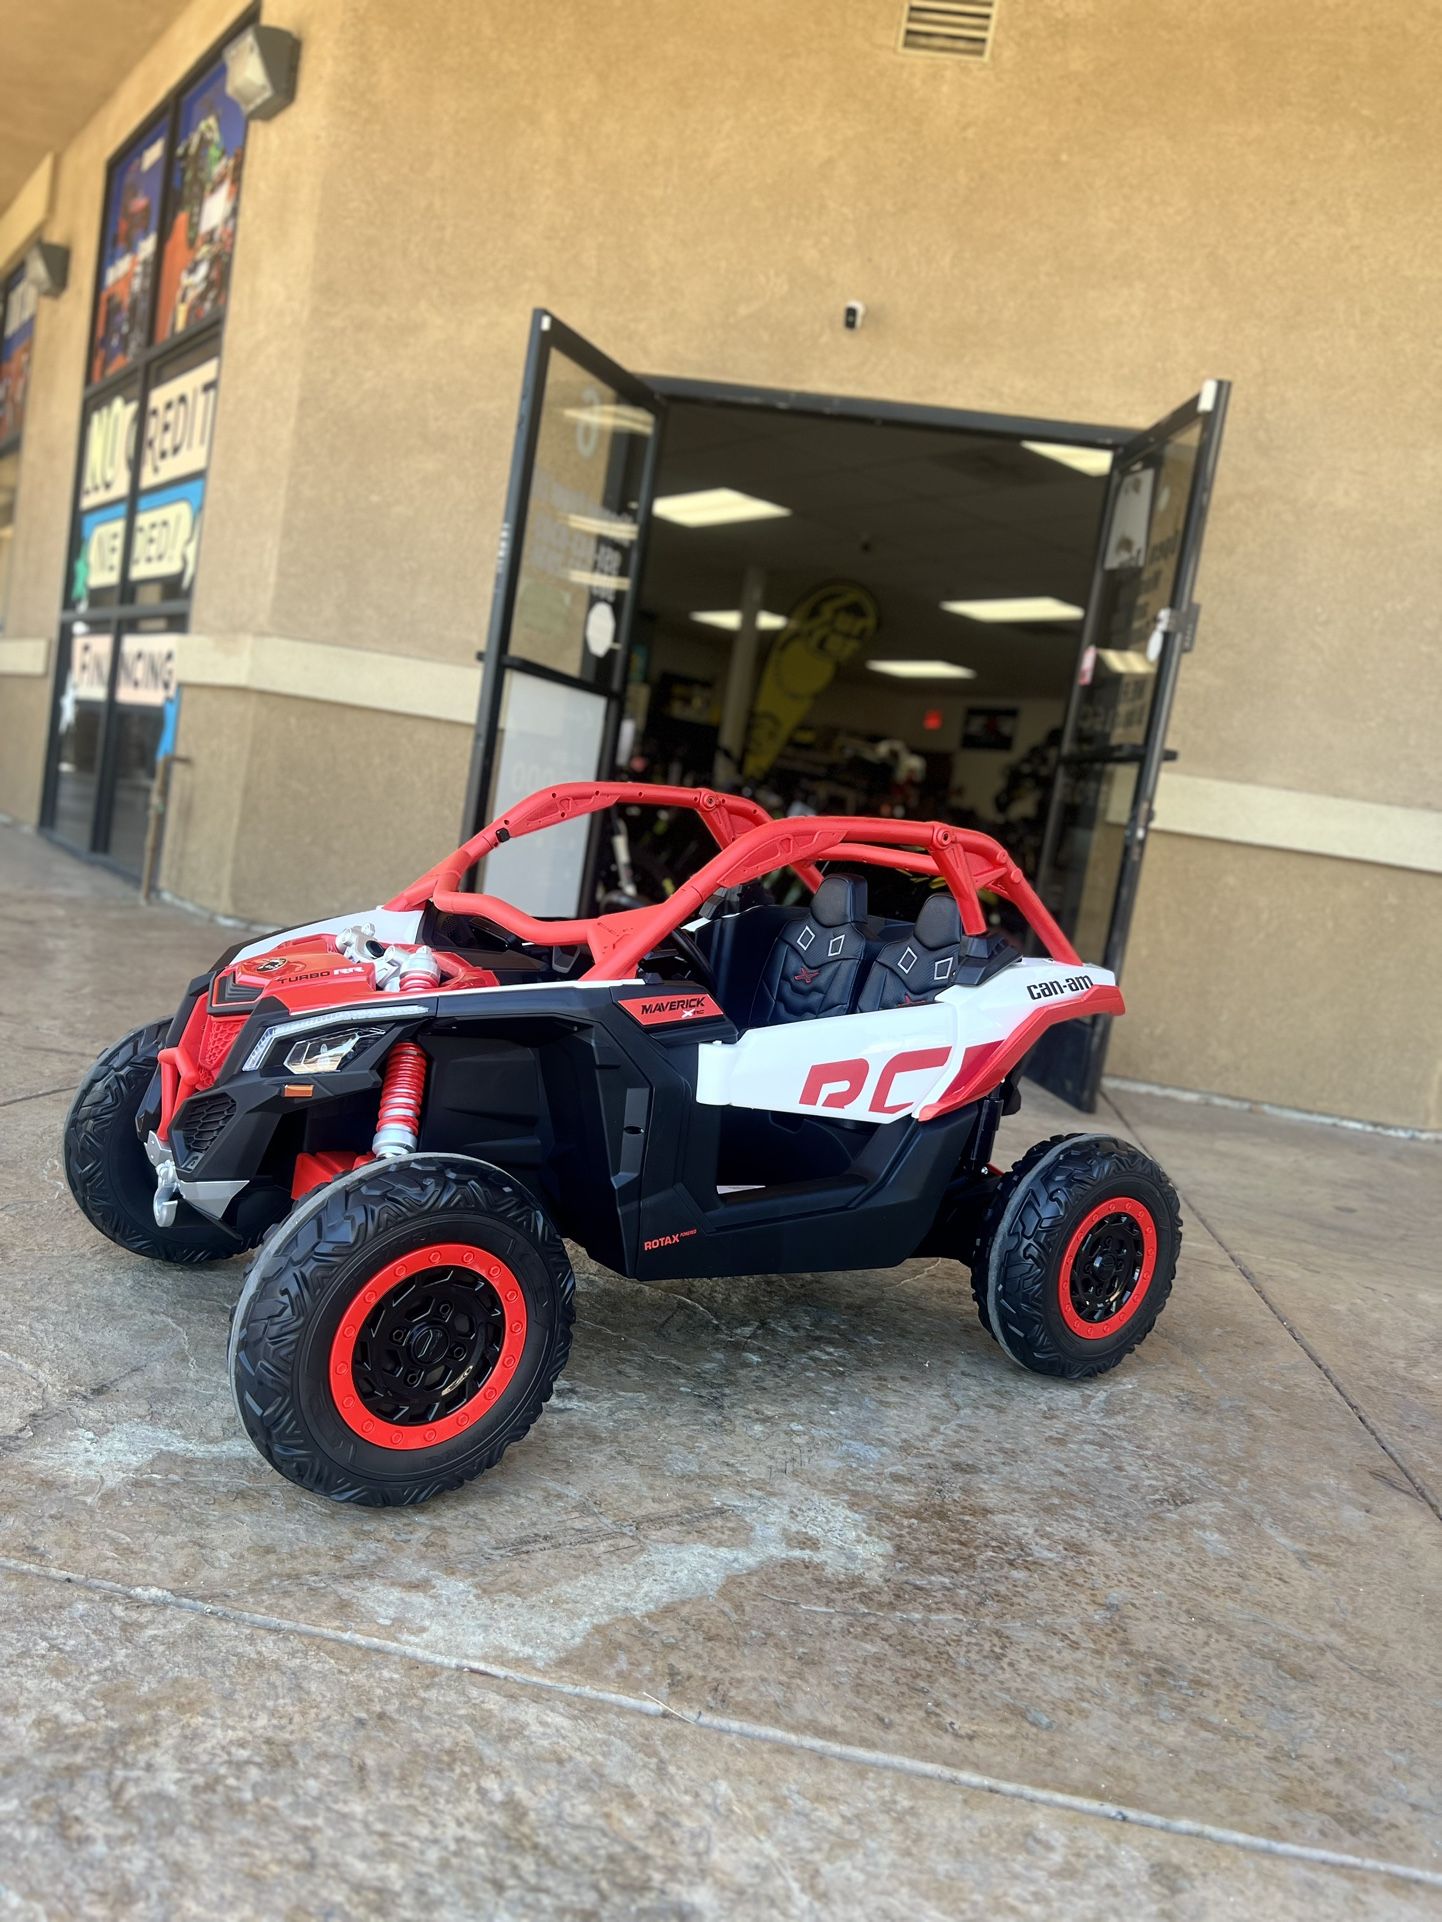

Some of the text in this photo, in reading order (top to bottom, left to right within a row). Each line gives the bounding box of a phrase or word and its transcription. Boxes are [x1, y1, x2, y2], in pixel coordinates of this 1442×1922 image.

[94, 512, 182, 574] NEDED!
[80, 643, 175, 694] FINNCING
[277, 967, 365, 984] TURBO RR
[1026, 975, 1094, 1000] can-am
[641, 997, 706, 1015] MAVERICK
[644, 1233, 680, 1251] ROTAX
